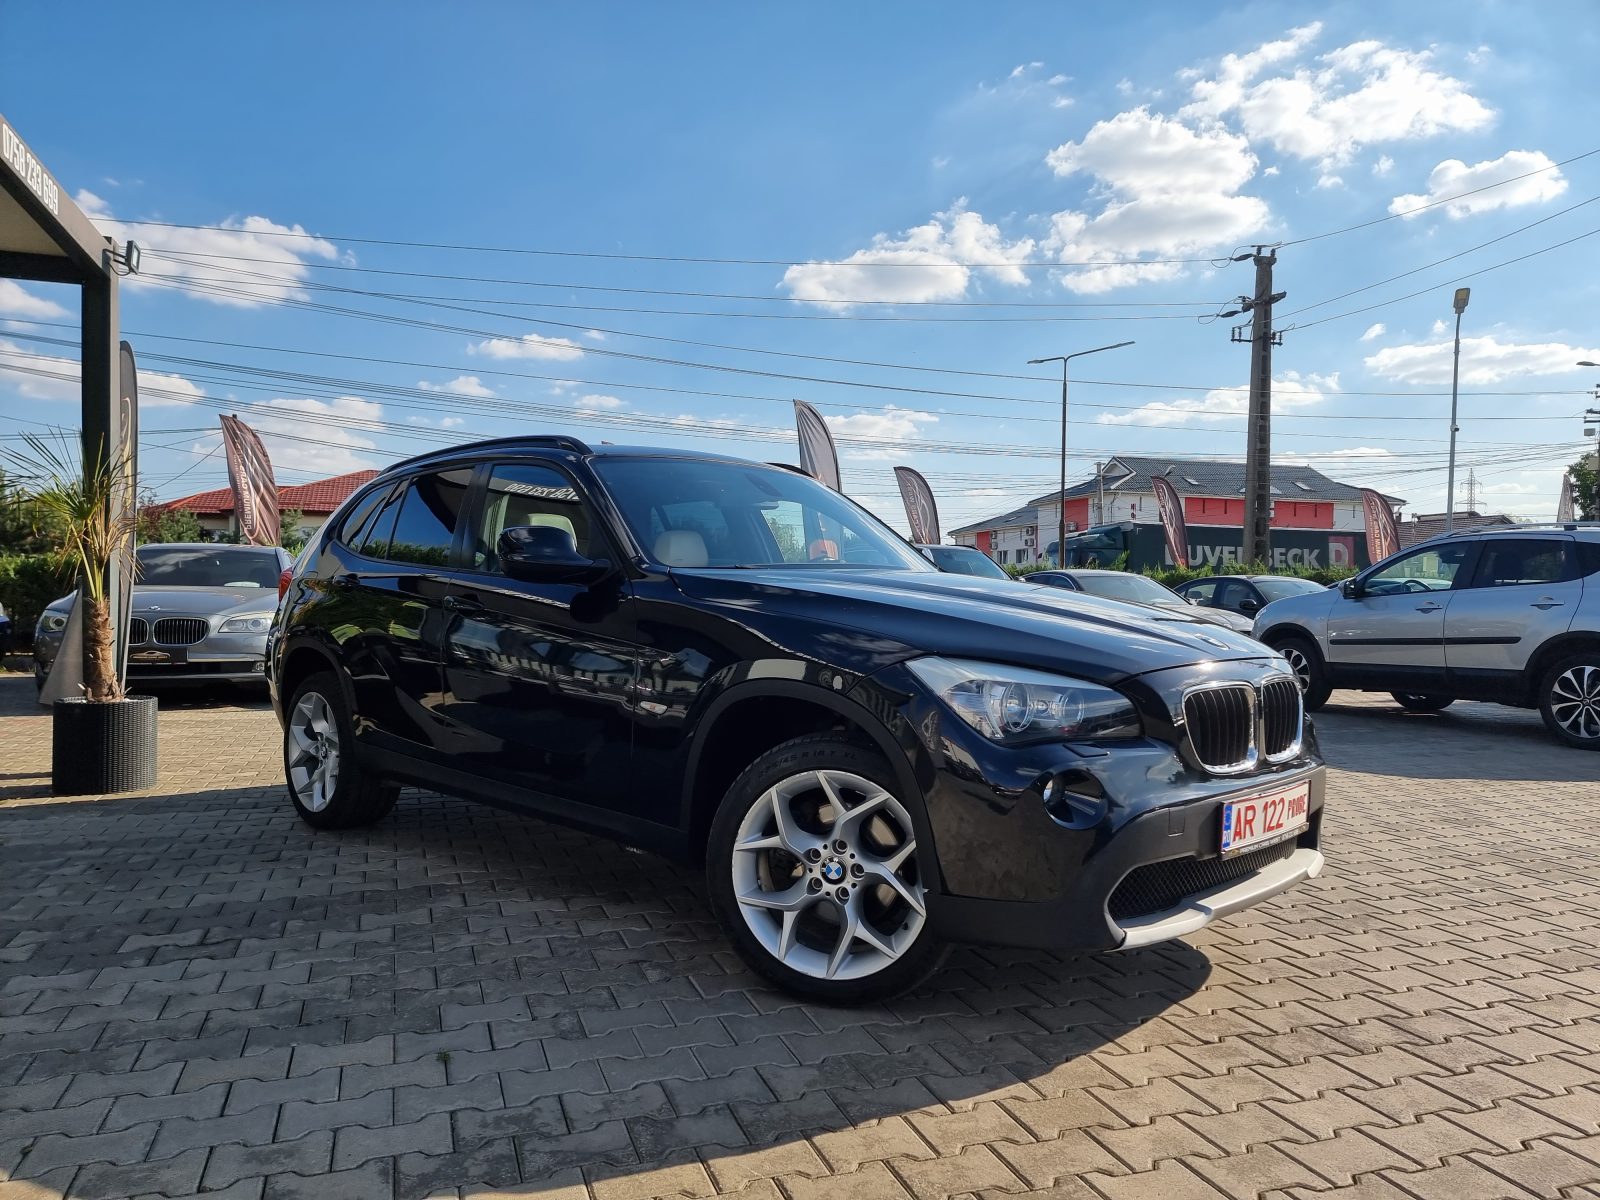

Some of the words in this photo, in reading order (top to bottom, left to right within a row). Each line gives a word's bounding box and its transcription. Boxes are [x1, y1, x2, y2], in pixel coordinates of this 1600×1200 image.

[2, 123, 26, 178] 0758
[26, 152, 42, 196] 233
[43, 172, 59, 216] 699
[1165, 544, 1321, 569] UVEECK
[1233, 804, 1256, 842] AR
[1262, 797, 1285, 833] 122
